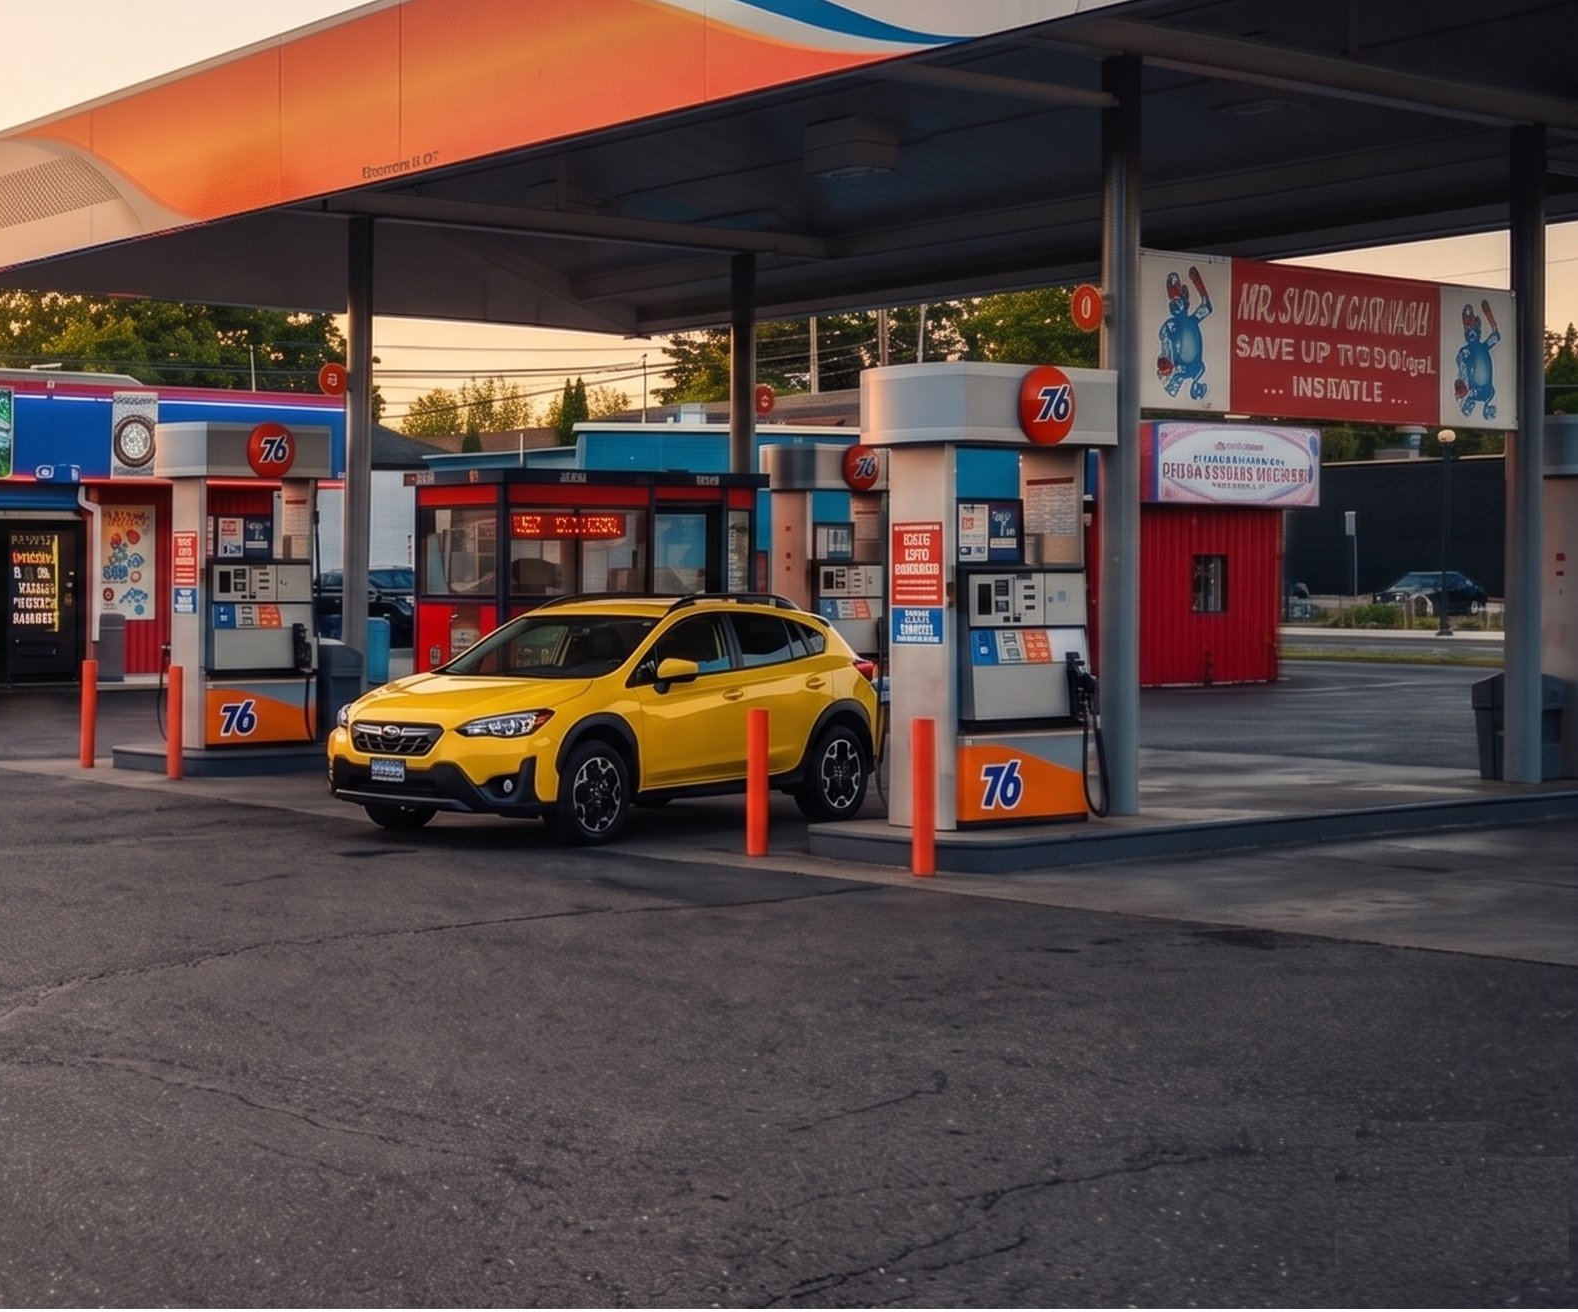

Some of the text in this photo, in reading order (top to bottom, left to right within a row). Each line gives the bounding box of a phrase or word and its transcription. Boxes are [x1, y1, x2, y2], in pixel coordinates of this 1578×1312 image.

[1236, 334, 1295, 361] SAVE
[1301, 340, 1331, 364] UP
[1033, 383, 1072, 423] 76
[258, 434, 290, 464] 76
[219, 698, 258, 737] 76
[979, 758, 1024, 811] 76
